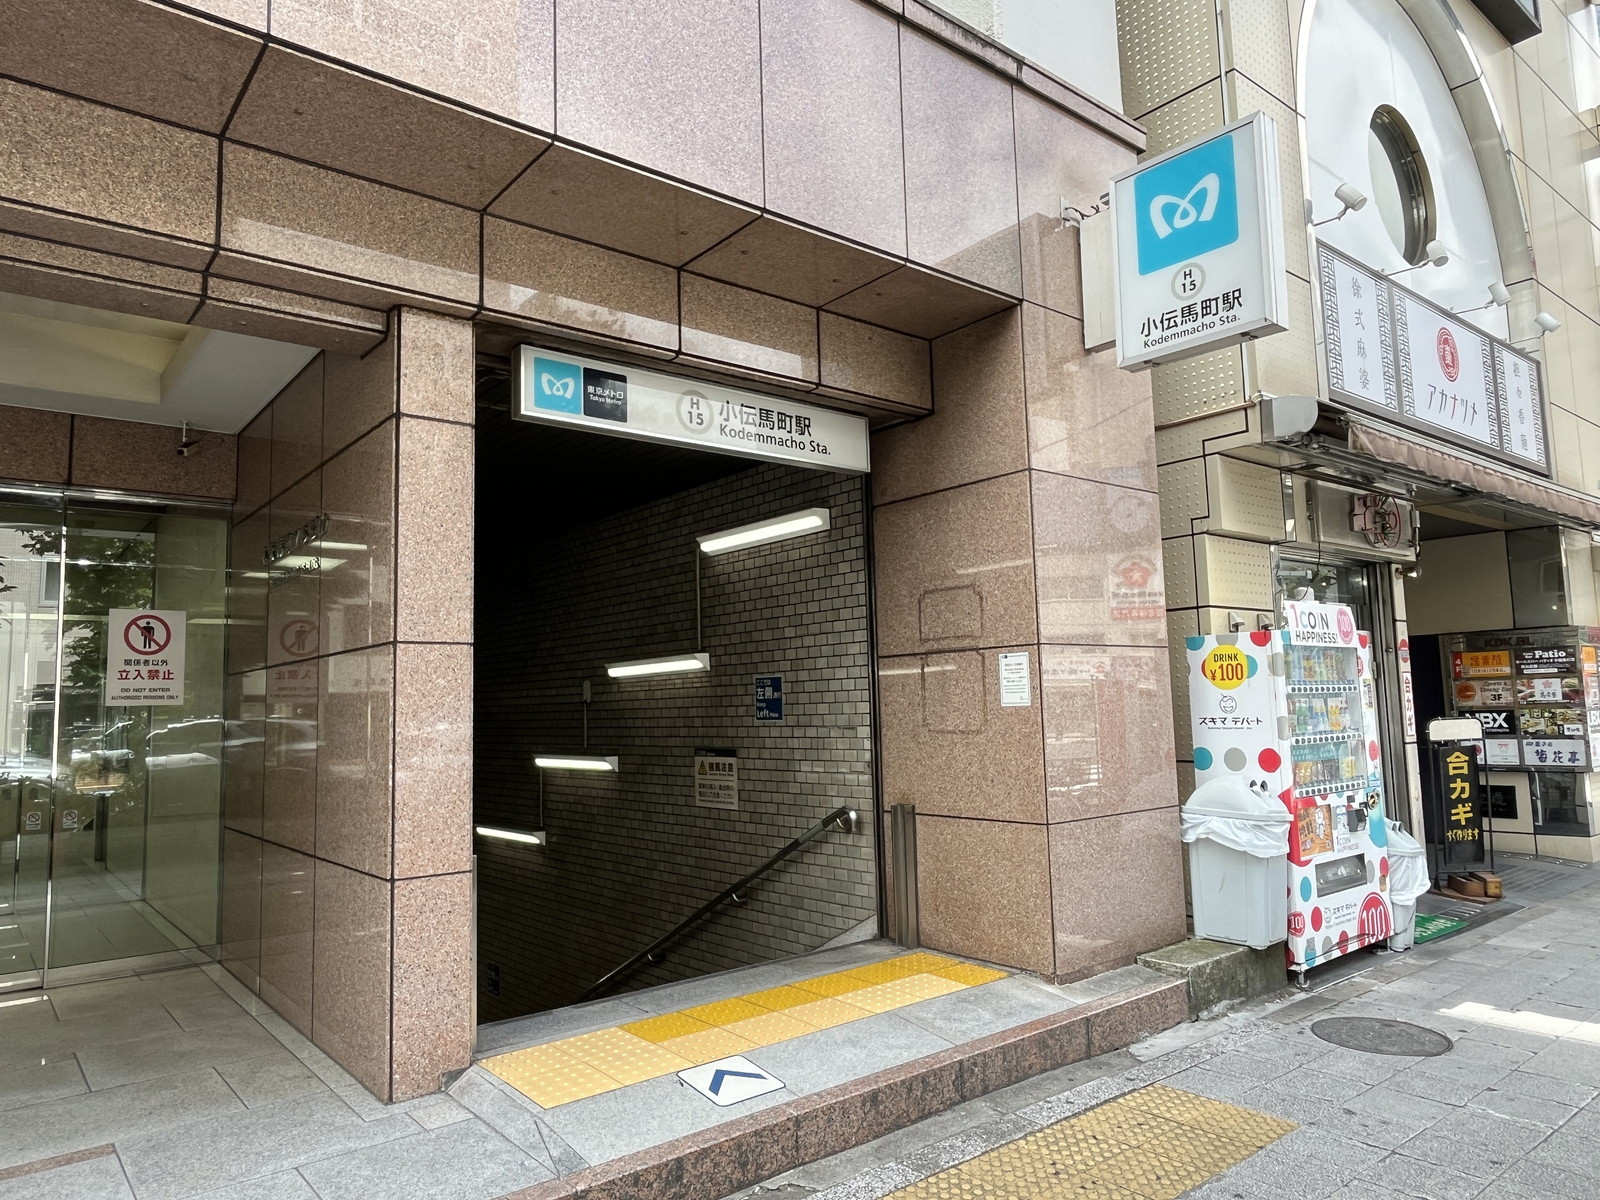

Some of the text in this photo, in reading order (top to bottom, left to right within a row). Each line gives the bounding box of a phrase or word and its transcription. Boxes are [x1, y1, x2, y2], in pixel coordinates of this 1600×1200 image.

[1183, 269, 1192, 280] H
[1181, 280, 1197, 293] 15
[1141, 287, 1243, 338] 小伝馬町駅
[1143, 310, 1241, 349] Kodemmacho Sta.
[587, 385, 624, 399] 東京メトロ
[590, 394, 622, 406] Tokyo Metro
[690, 398, 700, 410] H
[1427, 383, 1478, 427] アカナツメ
[687, 410, 705, 427] 15
[719, 400, 812, 438] 小伝馬町駅
[719, 423, 832, 456] Kodemmacho Sta.
[1295, 630, 1339, 644] HAPPINESS!
[1213, 653, 1239, 662] DRINK
[1534, 650, 1566, 658] Patio
[117, 669, 174, 680] 立入禁止
[1210, 663, 1244, 681] ¥100
[1490, 693, 1503, 701] 3F
[757, 708, 769, 718] Left
[1199, 717, 1263, 725] スキマ デパート
[1534, 749, 1580, 764] 梅花亭
[1446, 751, 1473, 825] 合カギ
